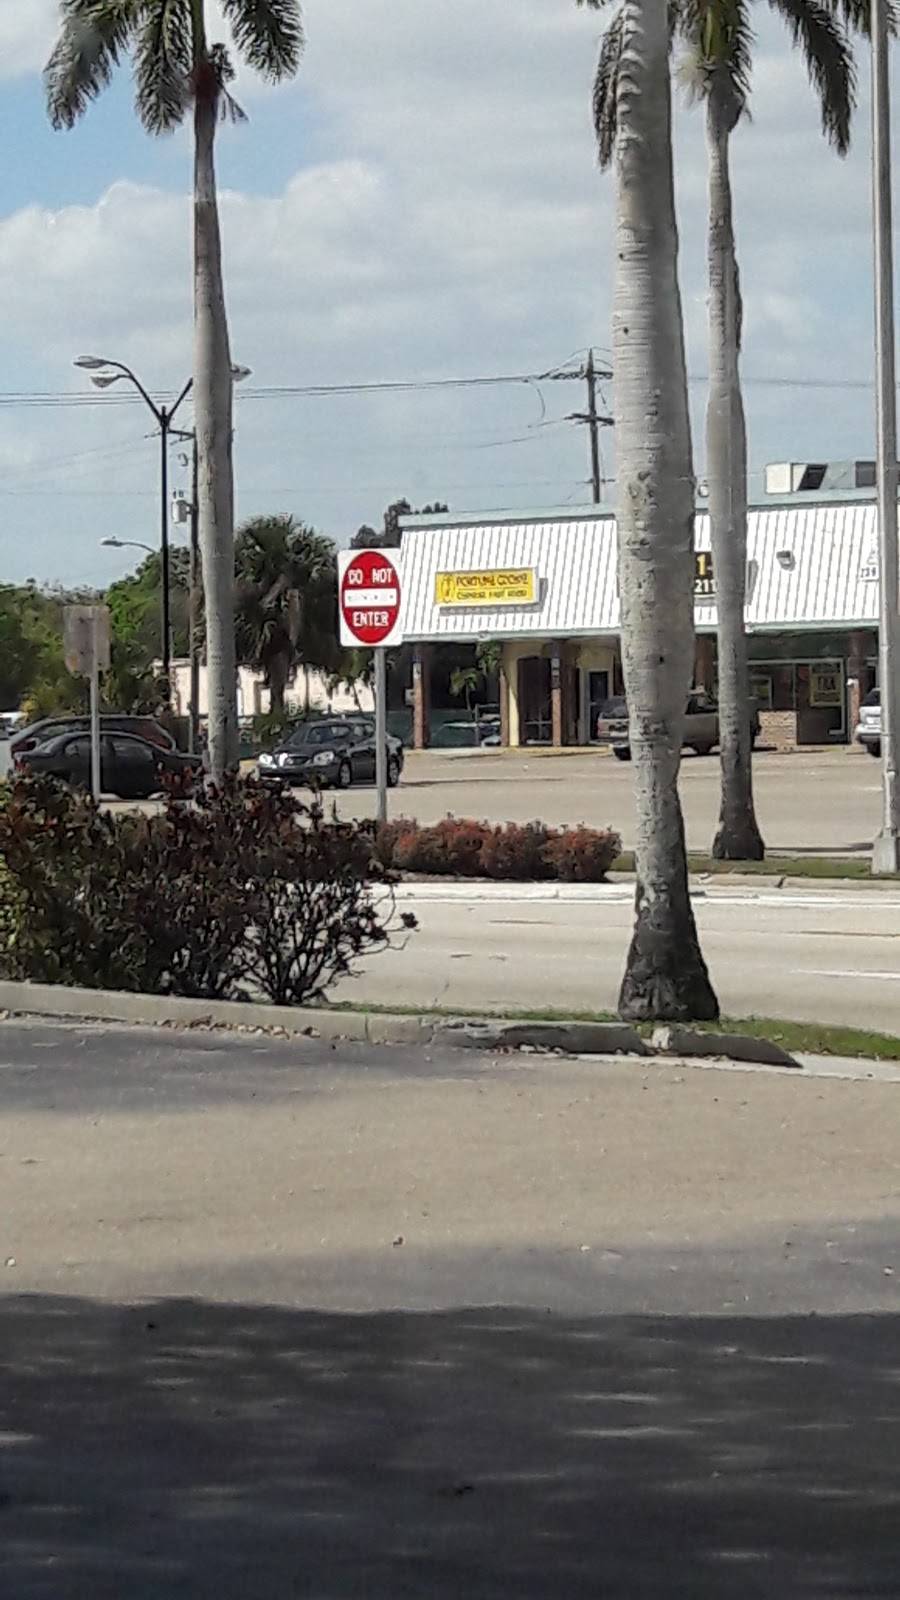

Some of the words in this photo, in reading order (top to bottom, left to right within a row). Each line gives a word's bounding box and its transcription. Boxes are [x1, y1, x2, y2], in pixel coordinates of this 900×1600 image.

[348, 569, 363, 585] DO
[372, 568, 393, 583] NOT
[352, 611, 389, 627] ENTER
